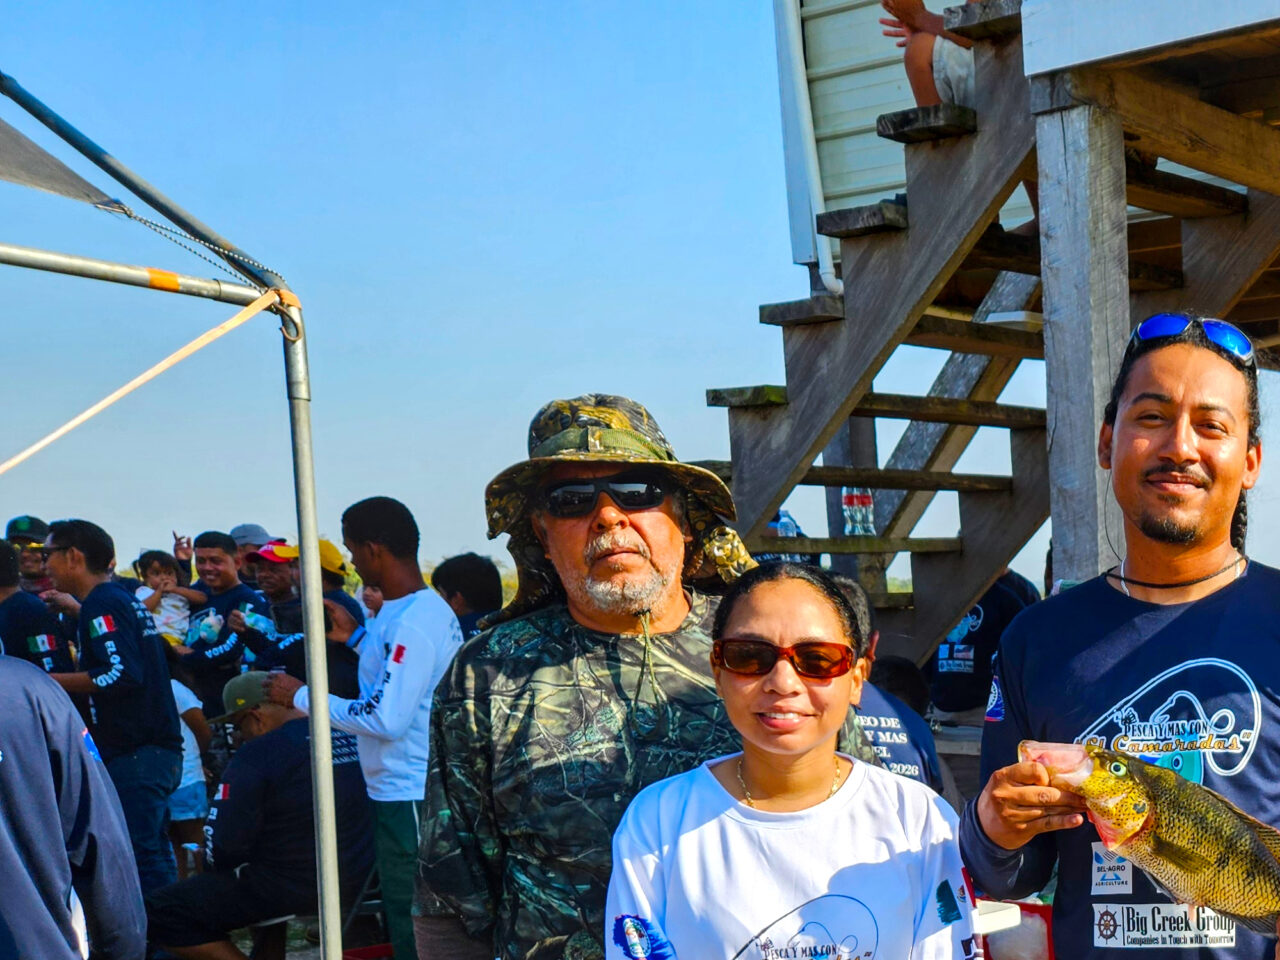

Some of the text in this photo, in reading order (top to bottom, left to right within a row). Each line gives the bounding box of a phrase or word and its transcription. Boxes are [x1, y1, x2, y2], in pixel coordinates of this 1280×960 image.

[856, 715, 901, 729] EO DE
[1123, 719, 1209, 738] PESCA Y MAS CON
[877, 731, 908, 744] MAS
[890, 762, 919, 776] 2026
[1097, 864, 1126, 873] BEL-AGRO
[1125, 906, 1235, 935] Big Creek Group
[1126, 935, 1159, 946] Companies
[1169, 934, 1188, 945] Touch
[1189, 934, 1203, 945] with
[1204, 934, 1235, 945] Tomorrow
[764, 948, 790, 960] PESCA
